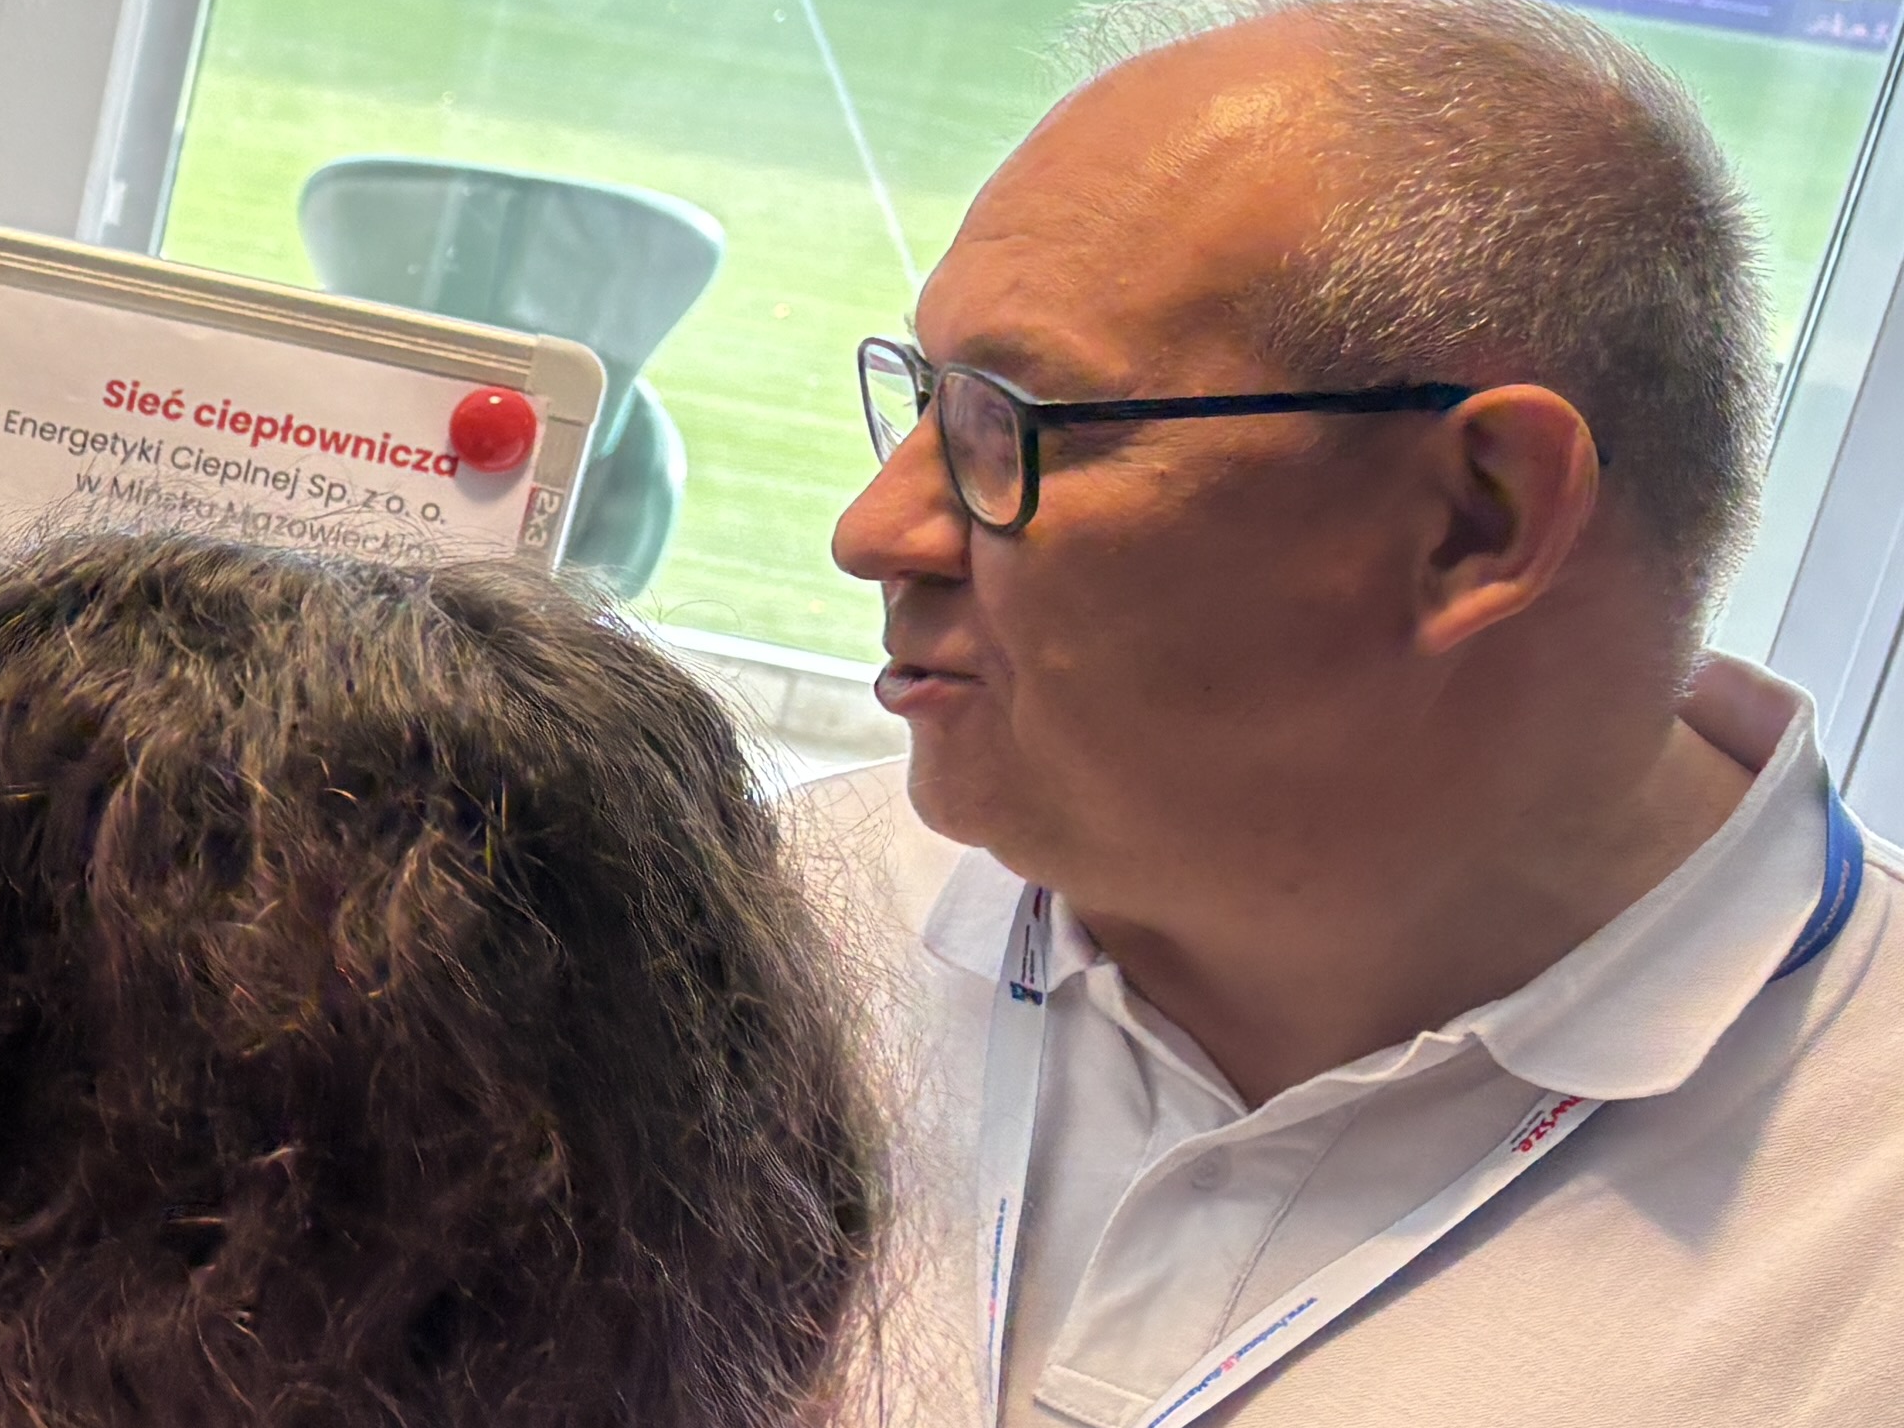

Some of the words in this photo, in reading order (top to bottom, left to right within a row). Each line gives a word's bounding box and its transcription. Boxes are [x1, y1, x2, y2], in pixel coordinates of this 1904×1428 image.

[3, 409, 163, 465] Energetyki
[171, 445, 302, 500] Cieplnej
[307, 473, 352, 509] Sp.
[362, 489, 379, 509] z
[385, 494, 411, 517] o.
[420, 502, 447, 525] o.
[103, 379, 186, 422] Sieć
[193, 399, 461, 479] ciepłownicza
